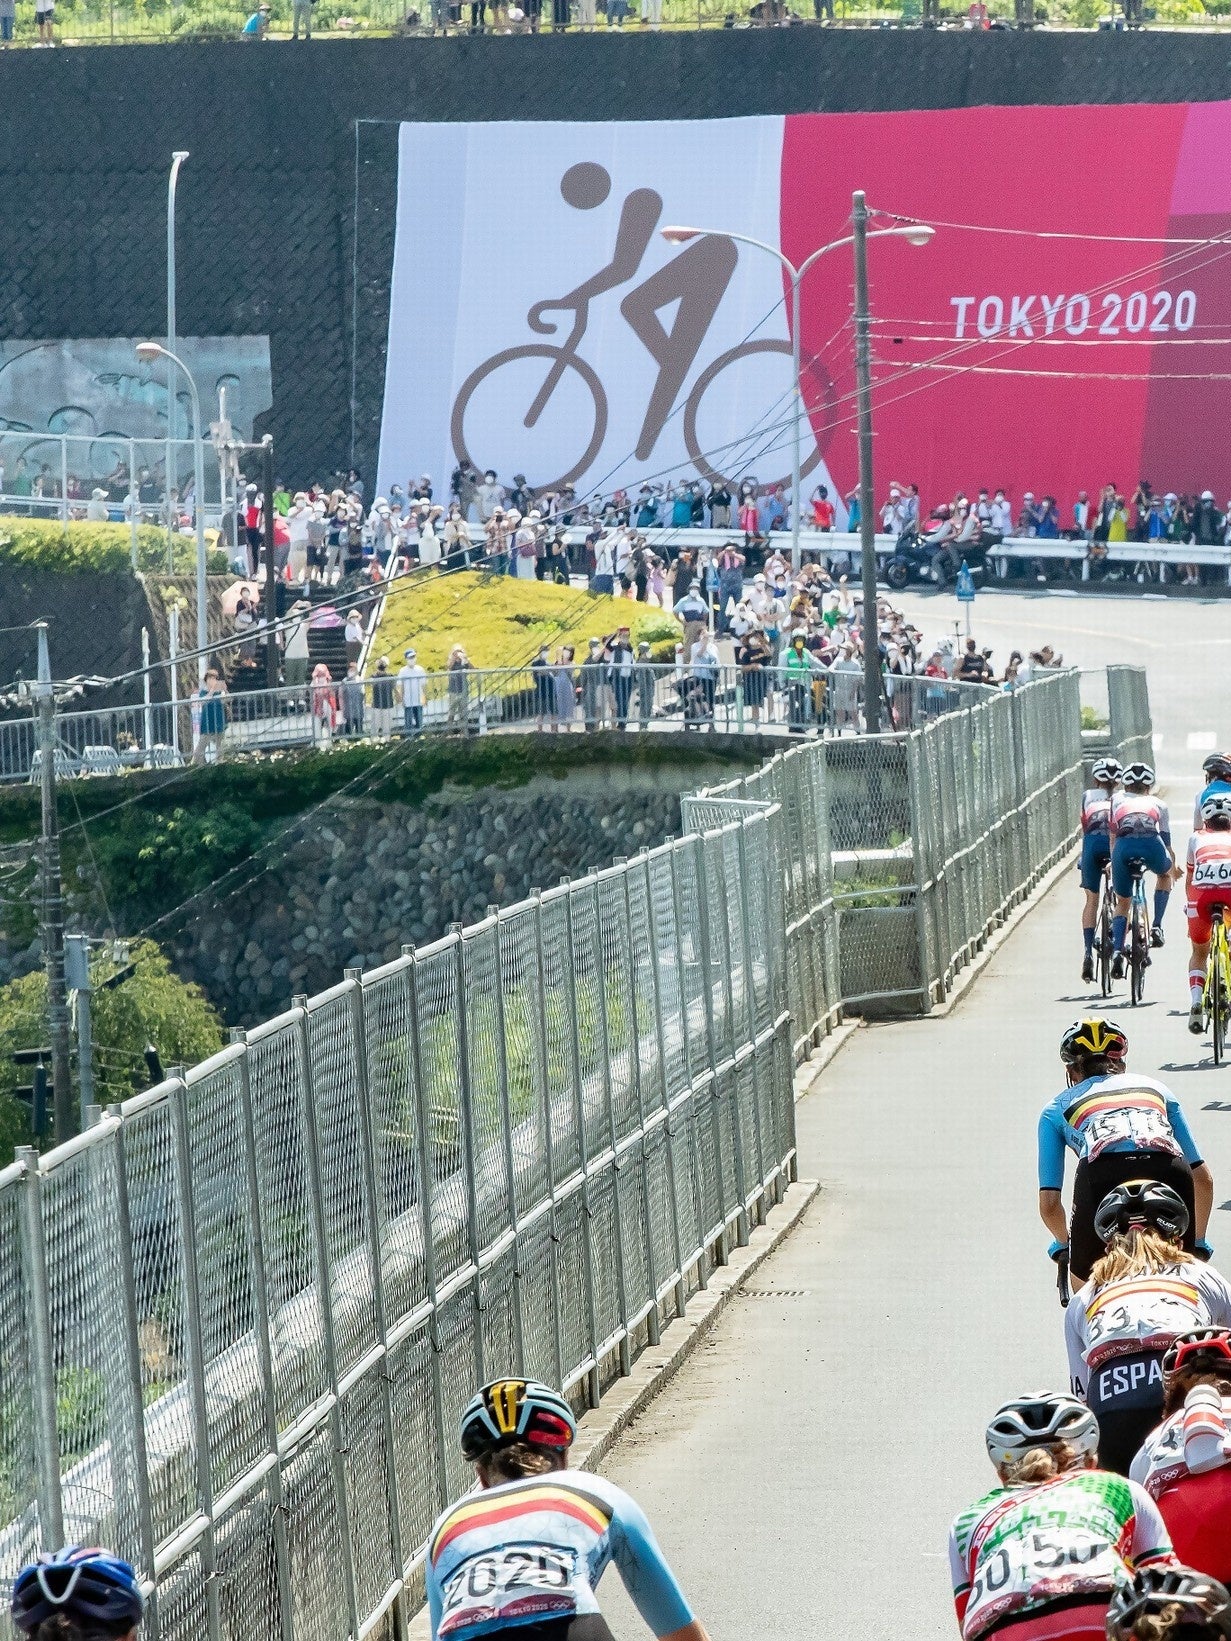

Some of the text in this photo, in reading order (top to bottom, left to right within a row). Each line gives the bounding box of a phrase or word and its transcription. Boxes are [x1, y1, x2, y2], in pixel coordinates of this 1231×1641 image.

[950, 290, 1197, 338] TOKYO 2020
[1195, 865, 1216, 881] 64
